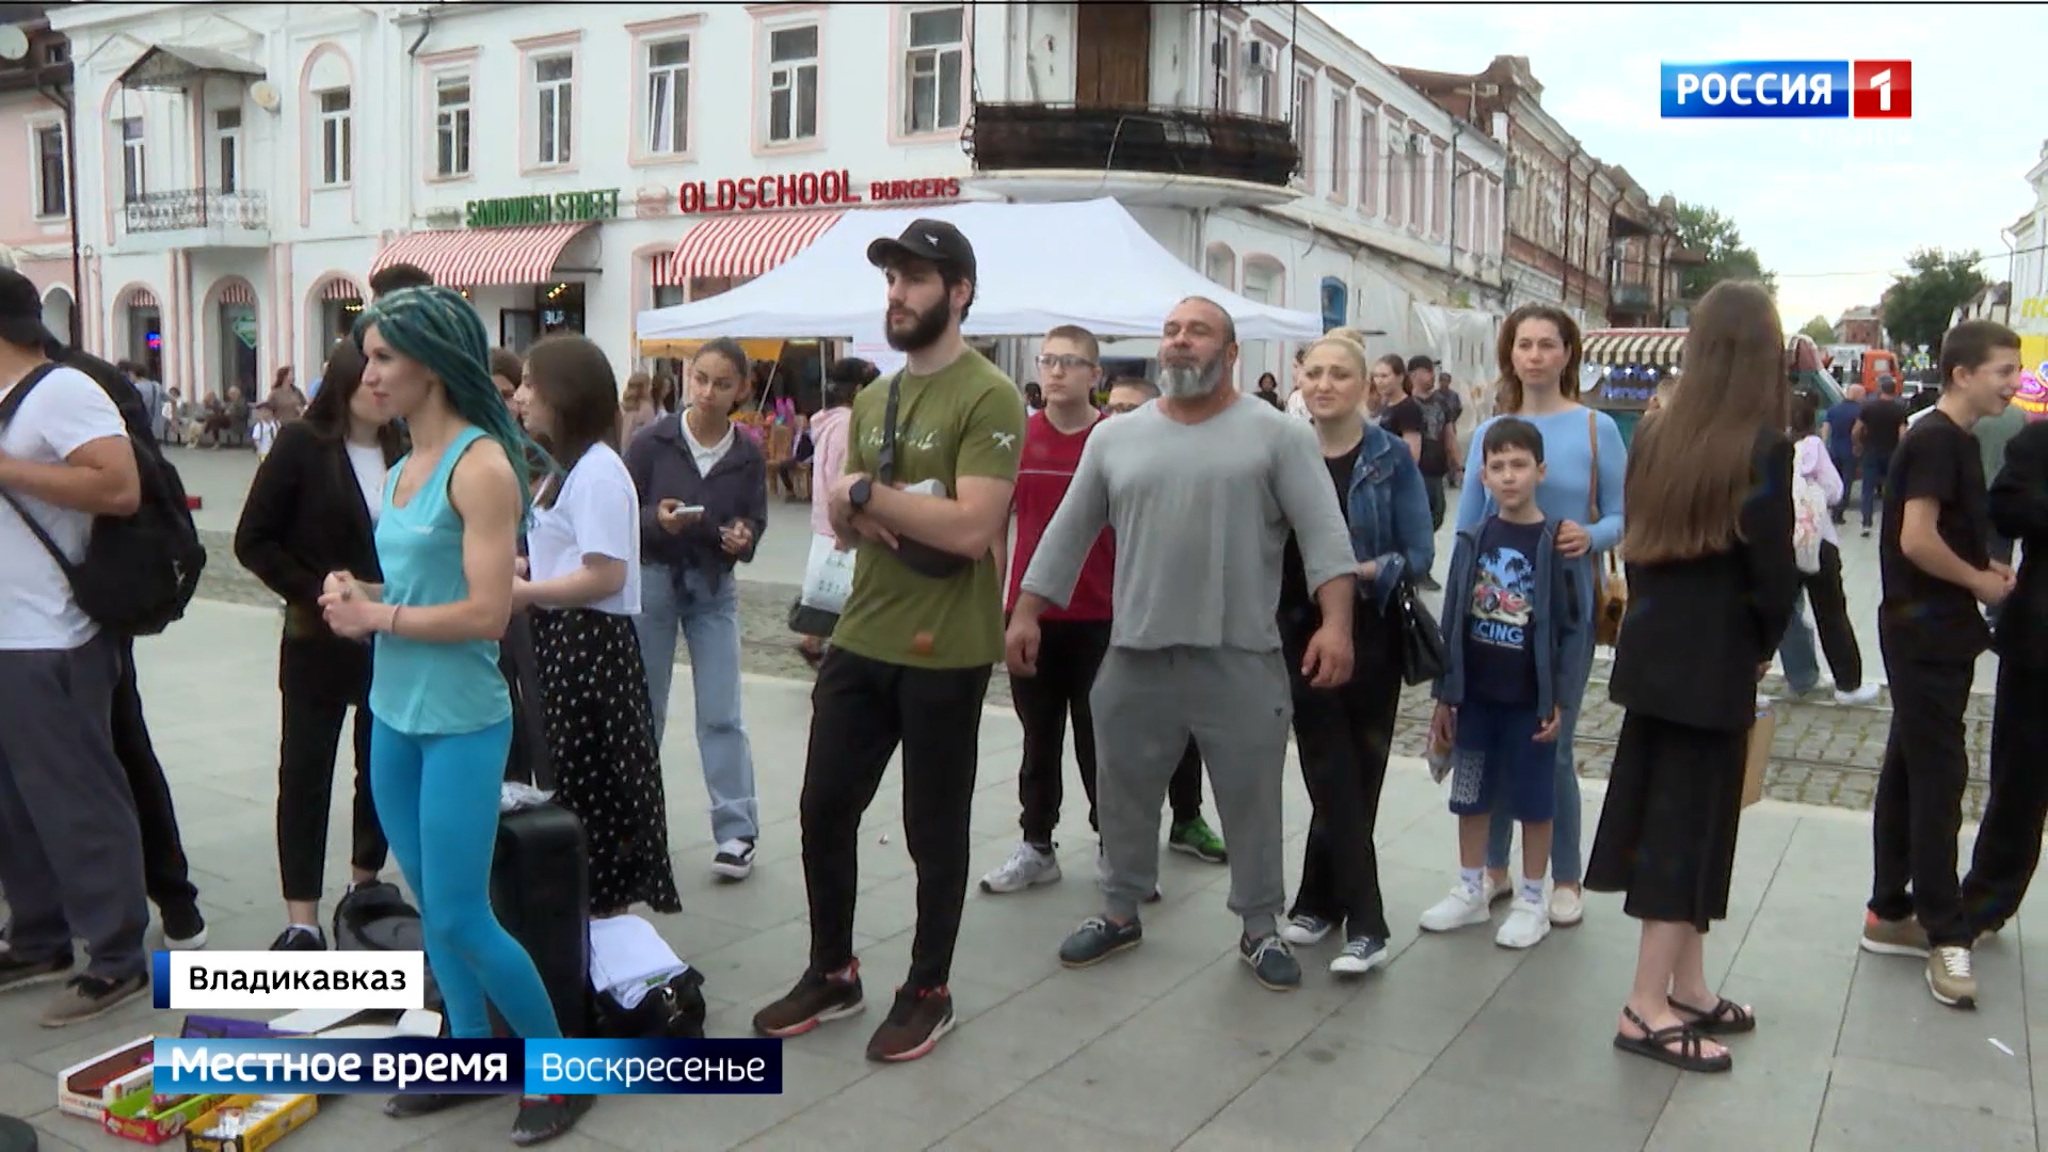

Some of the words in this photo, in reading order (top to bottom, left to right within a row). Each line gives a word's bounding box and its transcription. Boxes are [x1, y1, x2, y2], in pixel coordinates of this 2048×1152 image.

[466, 194, 551, 227] SANDWICH
[555, 188, 620, 220] STREET
[679, 169, 861, 213] OLDSCHOOL
[870, 177, 960, 200] BURGERS
[1474, 621, 1524, 644] CING
